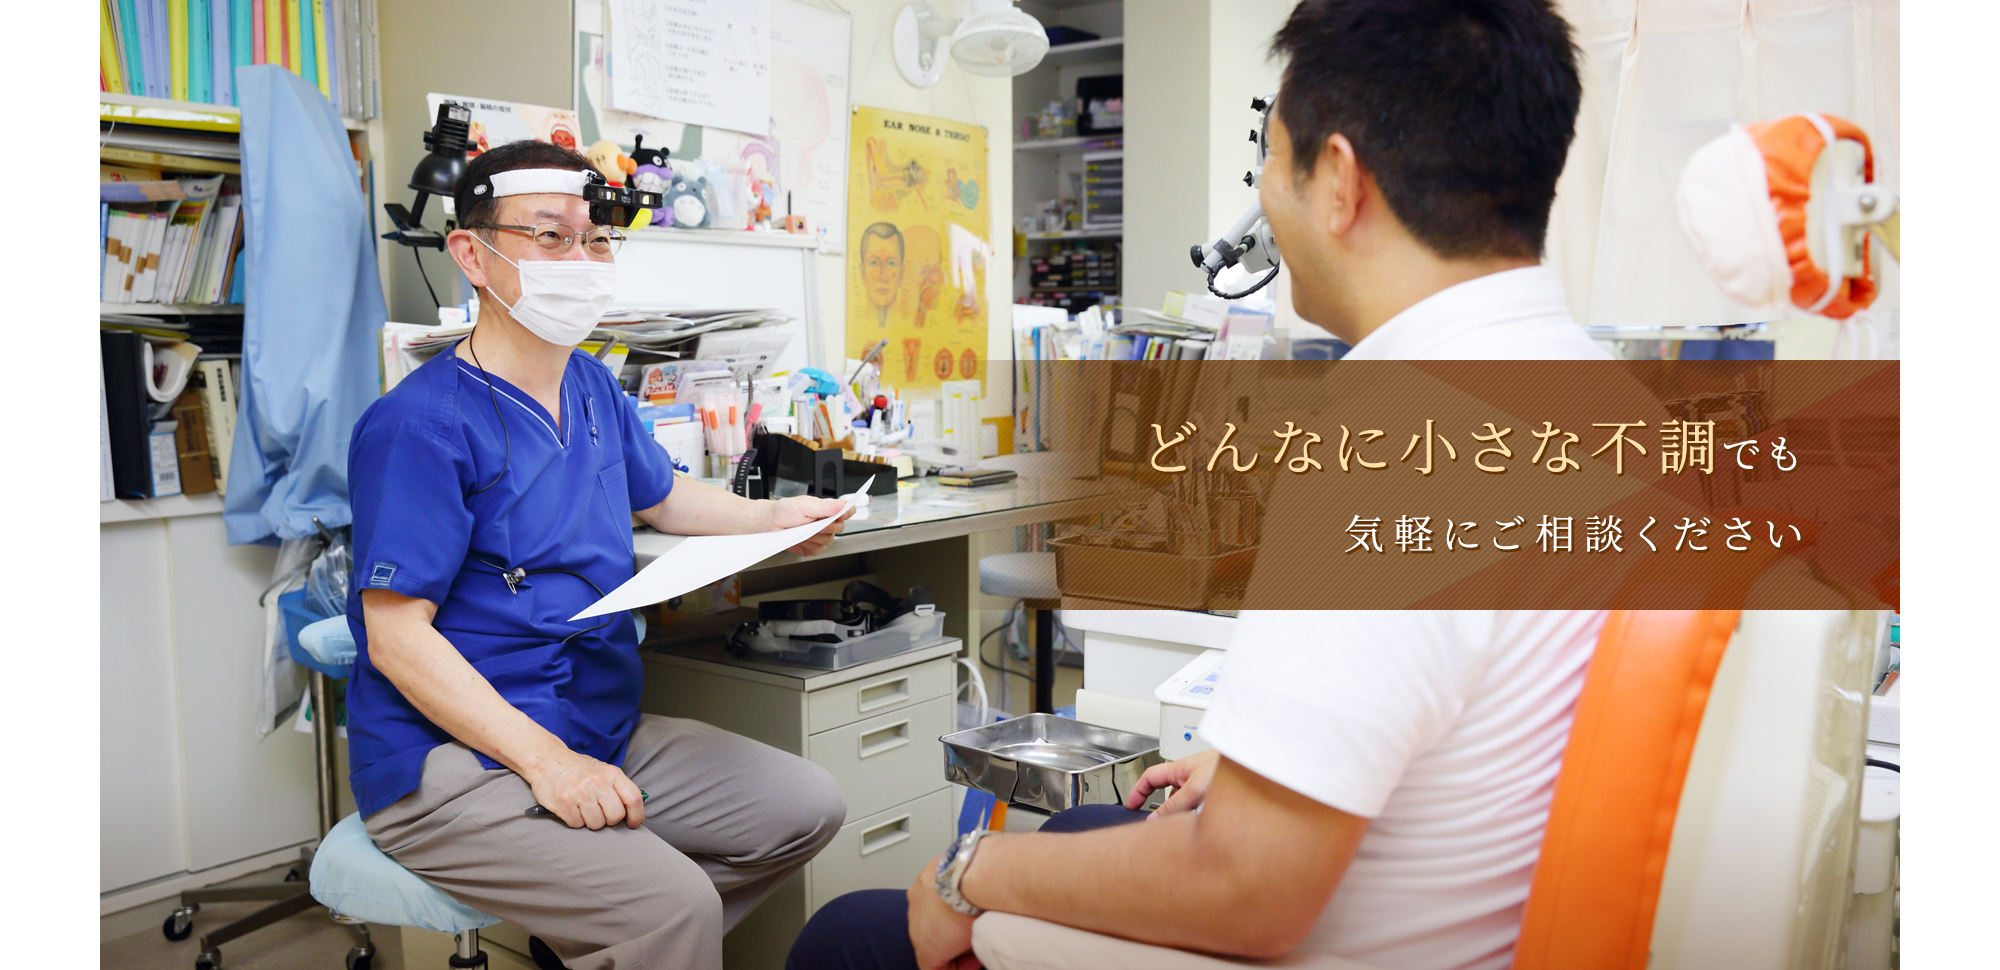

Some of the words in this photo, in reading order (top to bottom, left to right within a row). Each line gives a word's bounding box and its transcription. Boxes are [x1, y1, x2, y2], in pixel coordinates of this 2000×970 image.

[884, 119, 903, 130] EAR
[908, 123, 932, 135] NOSE
[935, 128, 941, 136] &
[945, 130, 970, 142] THROAT
